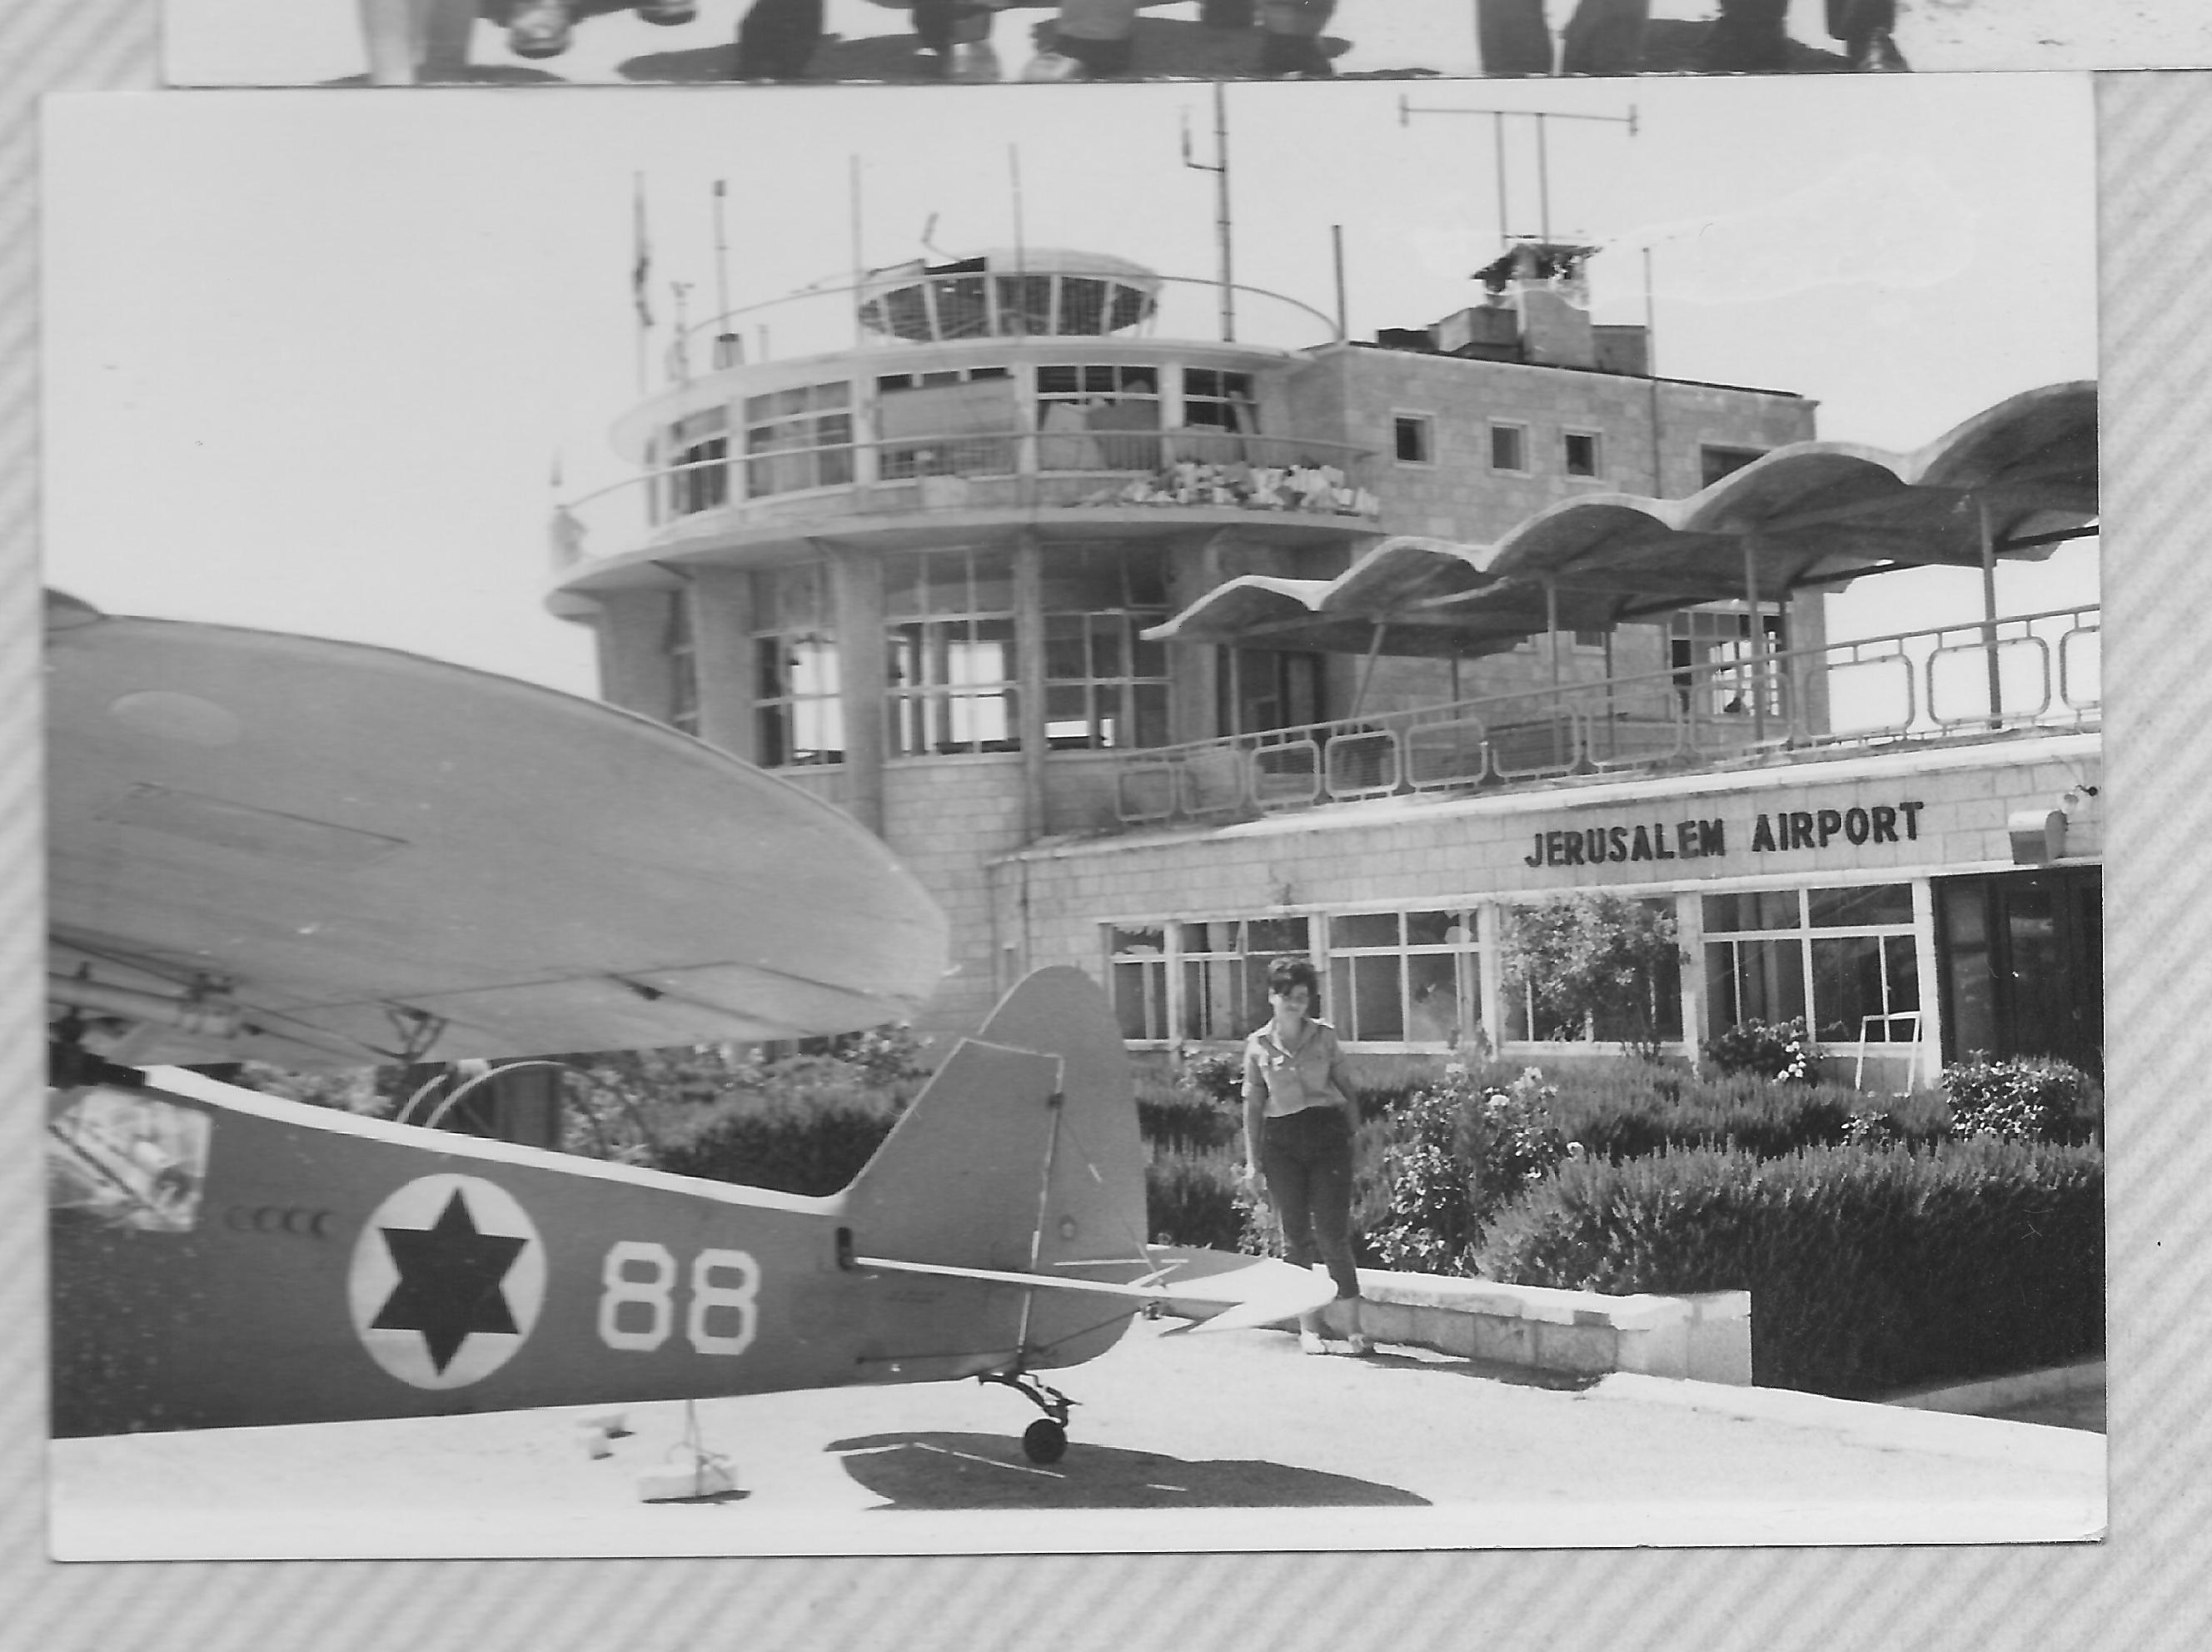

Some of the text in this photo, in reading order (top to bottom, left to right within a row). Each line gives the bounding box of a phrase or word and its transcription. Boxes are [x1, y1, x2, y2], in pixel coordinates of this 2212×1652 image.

[1525, 802, 1925, 868] JERUSALEM AIRPORT
[599, 1241, 760, 1355] 88
